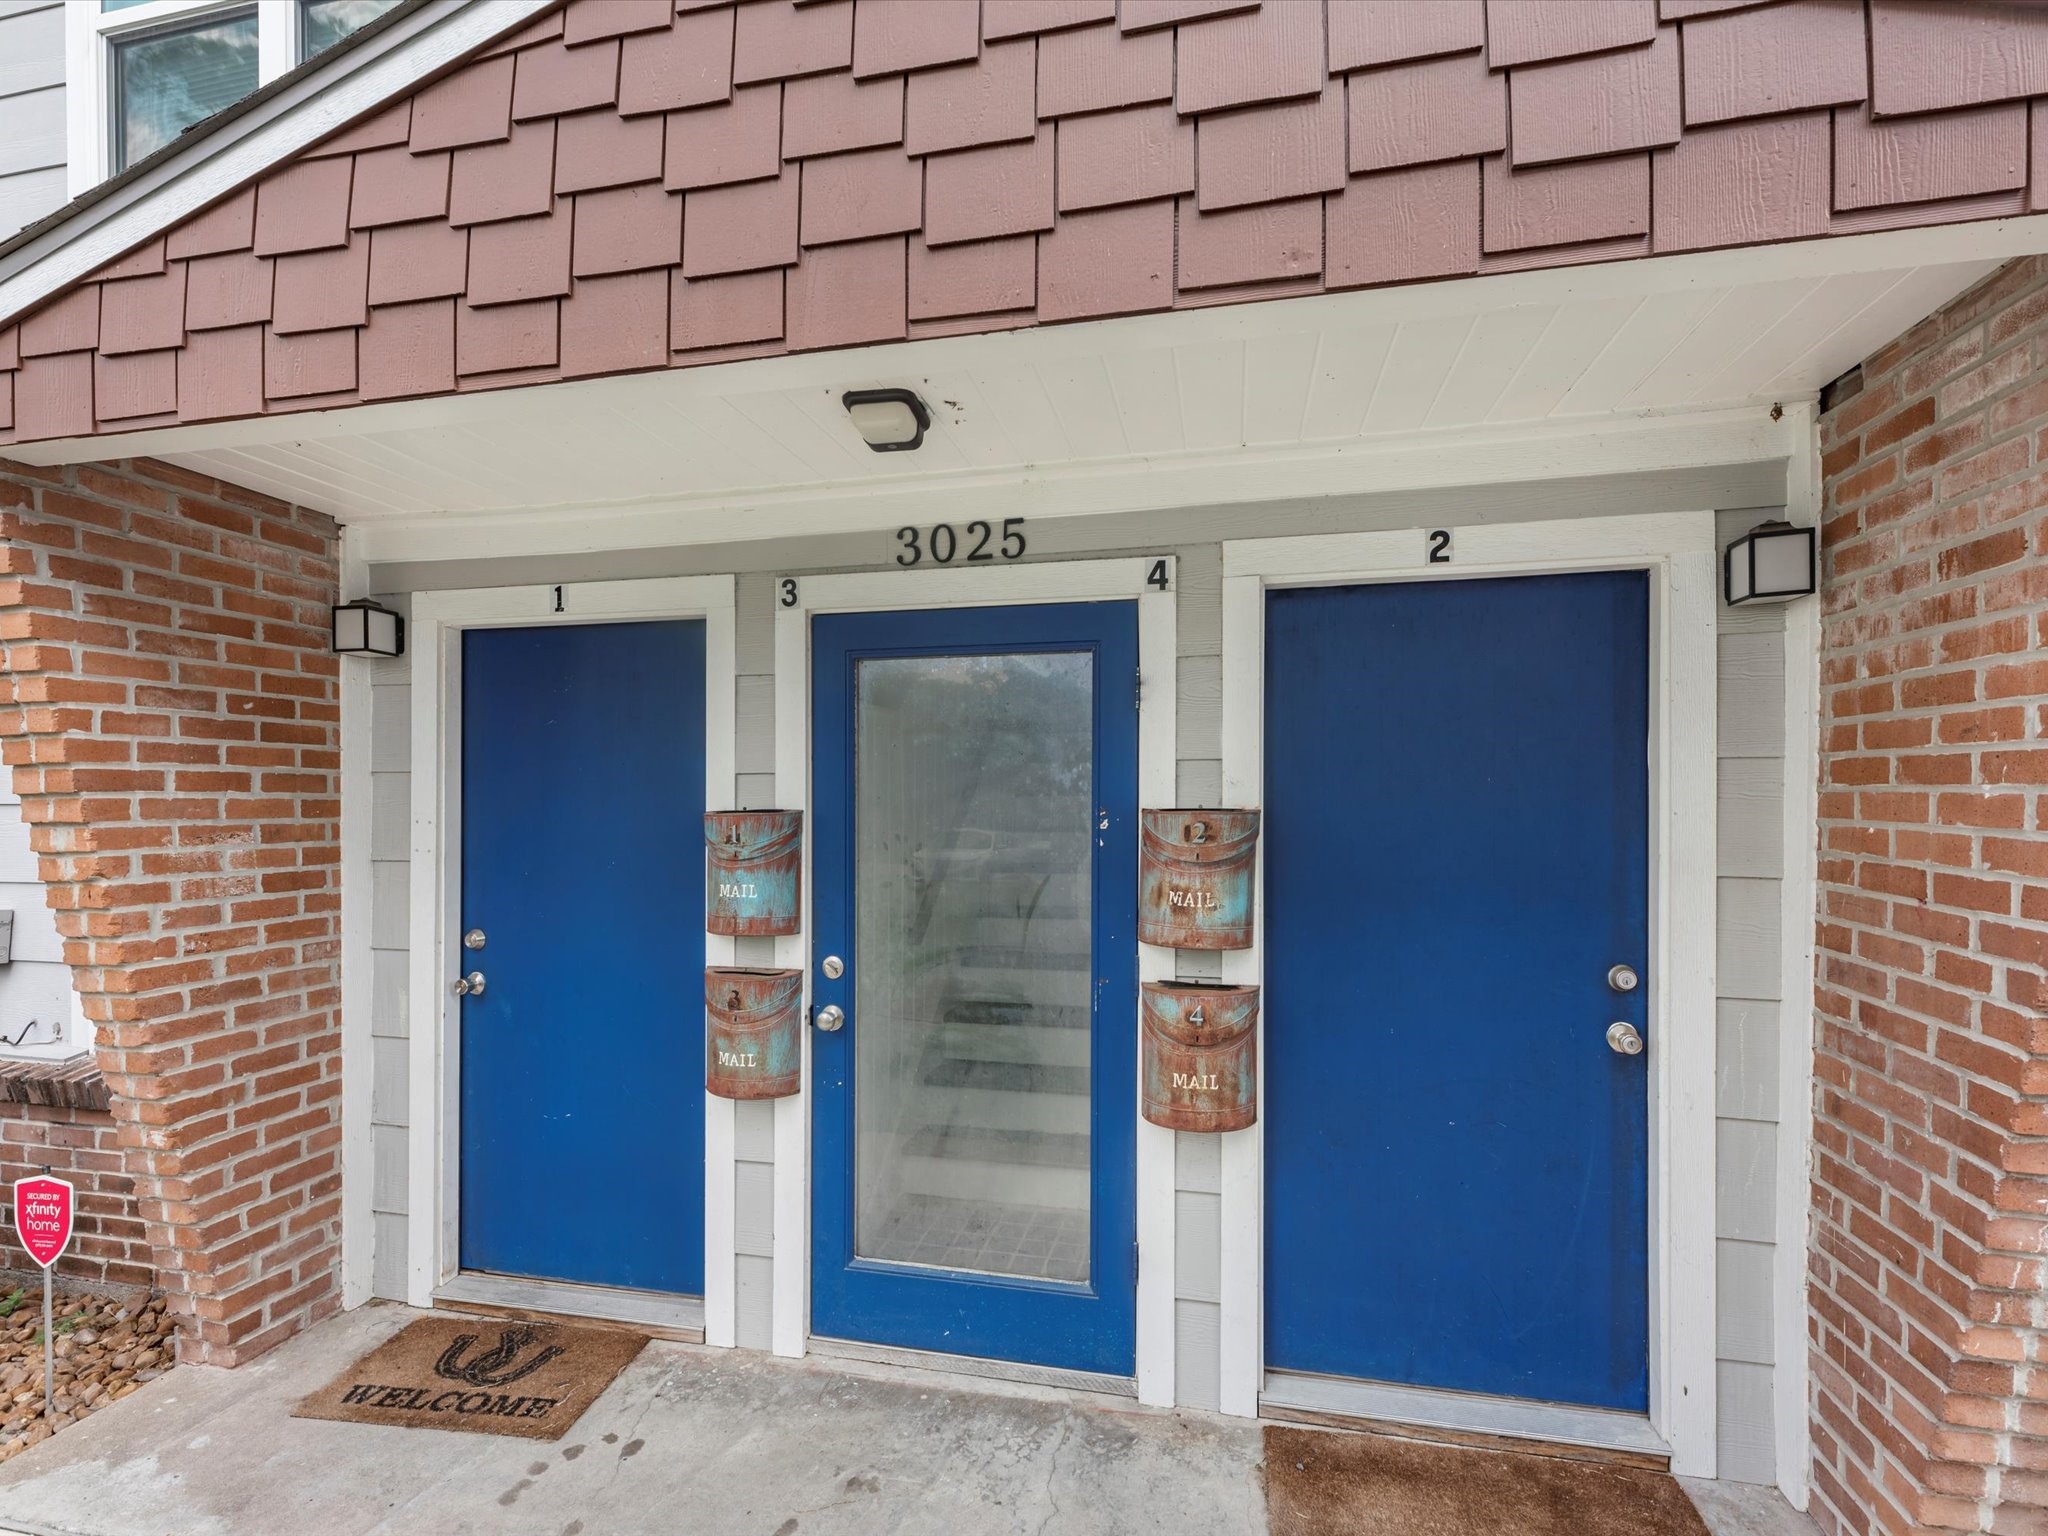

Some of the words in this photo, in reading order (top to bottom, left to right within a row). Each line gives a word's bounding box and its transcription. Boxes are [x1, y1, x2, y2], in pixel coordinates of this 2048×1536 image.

[896, 517, 1026, 566] 3025
[1429, 530, 1450, 563] 2
[1147, 559, 1169, 590] 4
[554, 585, 565, 612] 1
[781, 578, 798, 607] 3
[1192, 822, 1206, 844] 2
[719, 884, 758, 898] MAIL
[1168, 890, 1215, 908] MAIL
[1189, 1005, 1204, 1026] 4
[718, 1051, 757, 1067] MAIL
[1172, 1072, 1219, 1090] MAIL
[26, 1192, 52, 1200] SECURED
[52, 1193, 60, 1201] BY
[25, 1201, 61, 1219] xfinity
[26, 1217, 60, 1232] home
[340, 1383, 558, 1419] WELCOME
